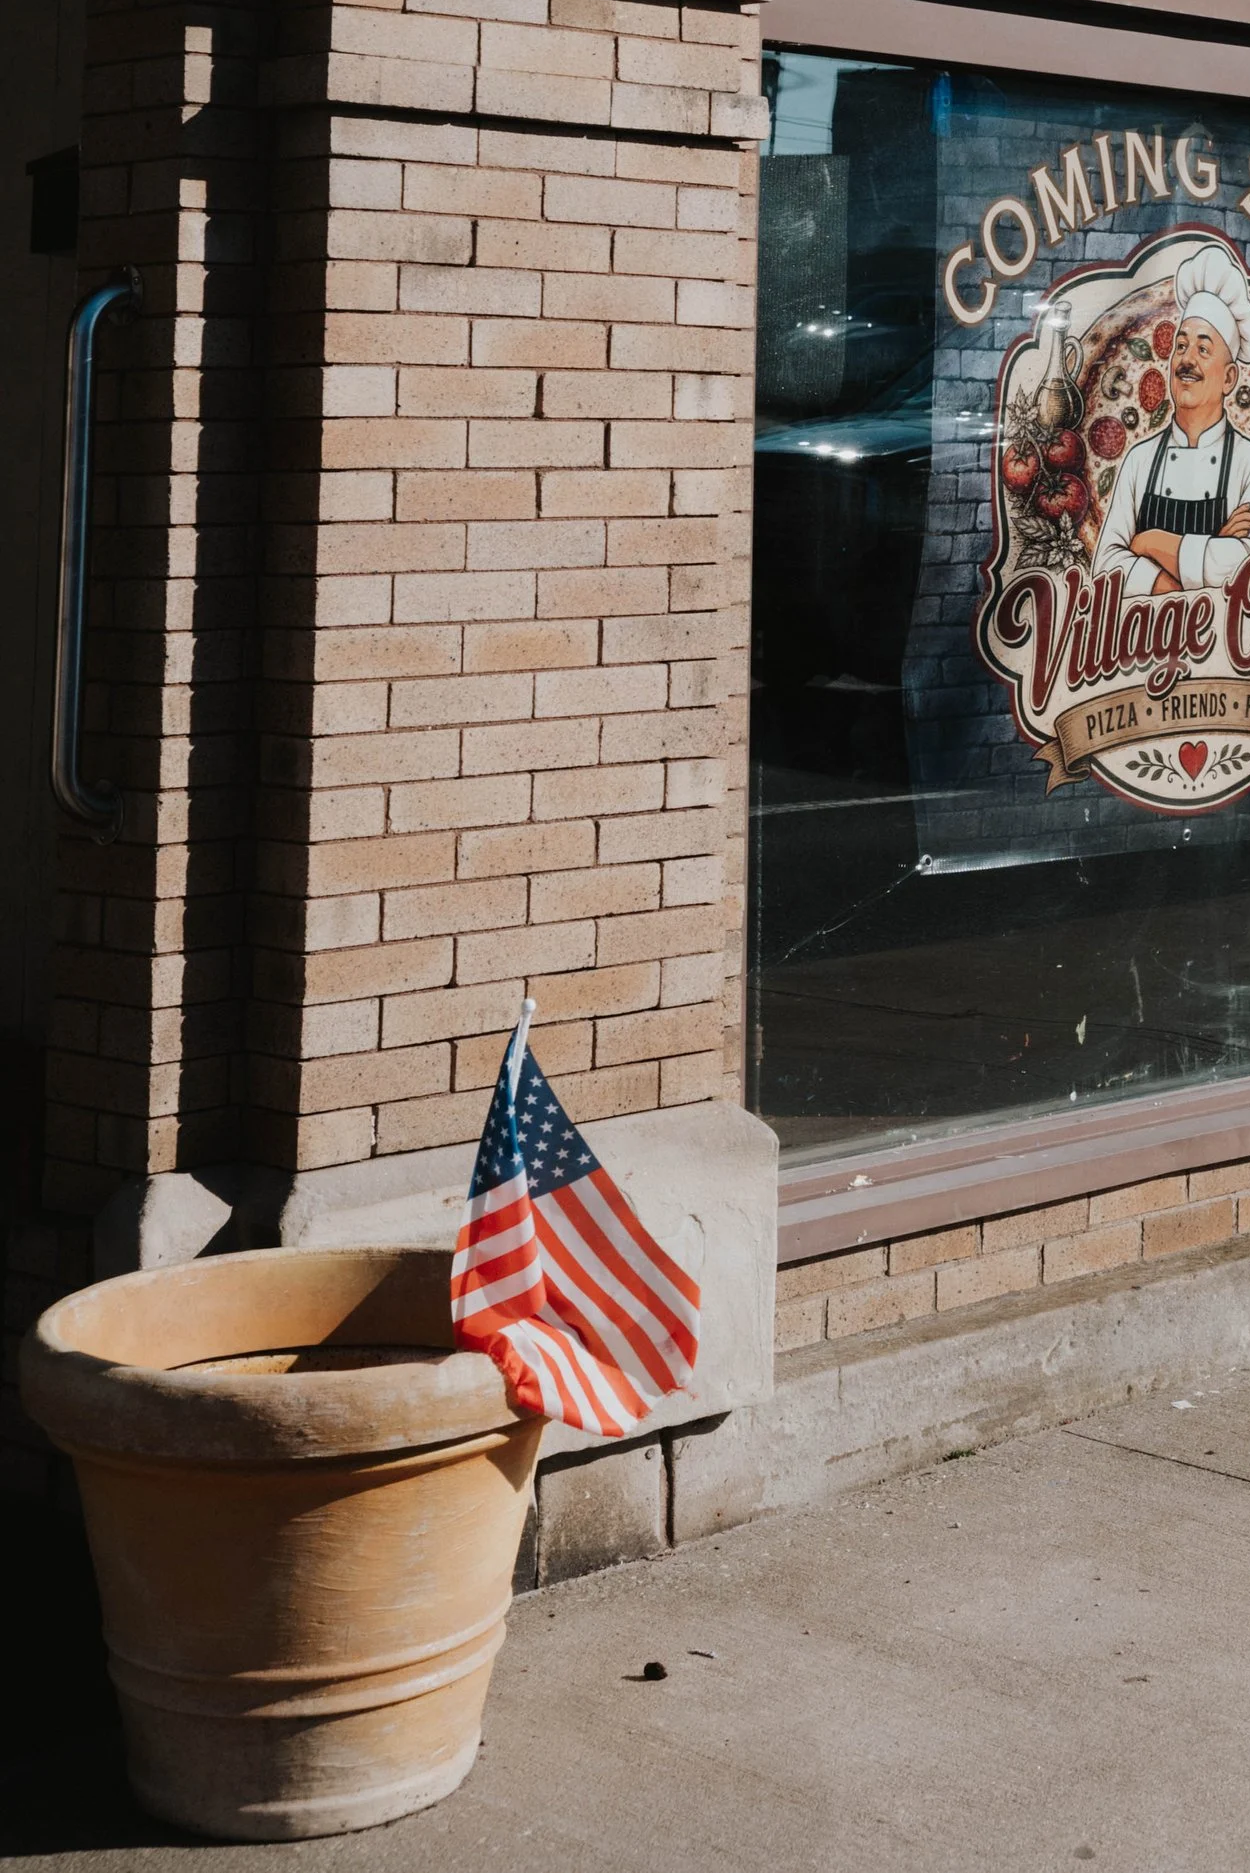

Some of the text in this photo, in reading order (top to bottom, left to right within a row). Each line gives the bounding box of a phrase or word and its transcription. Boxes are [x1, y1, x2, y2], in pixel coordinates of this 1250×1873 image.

[943, 126, 1219, 325] COMING
[996, 562, 1217, 714] Village
[1085, 701, 1139, 740] PIZZA
[1161, 692, 1228, 722] FRIENDS
